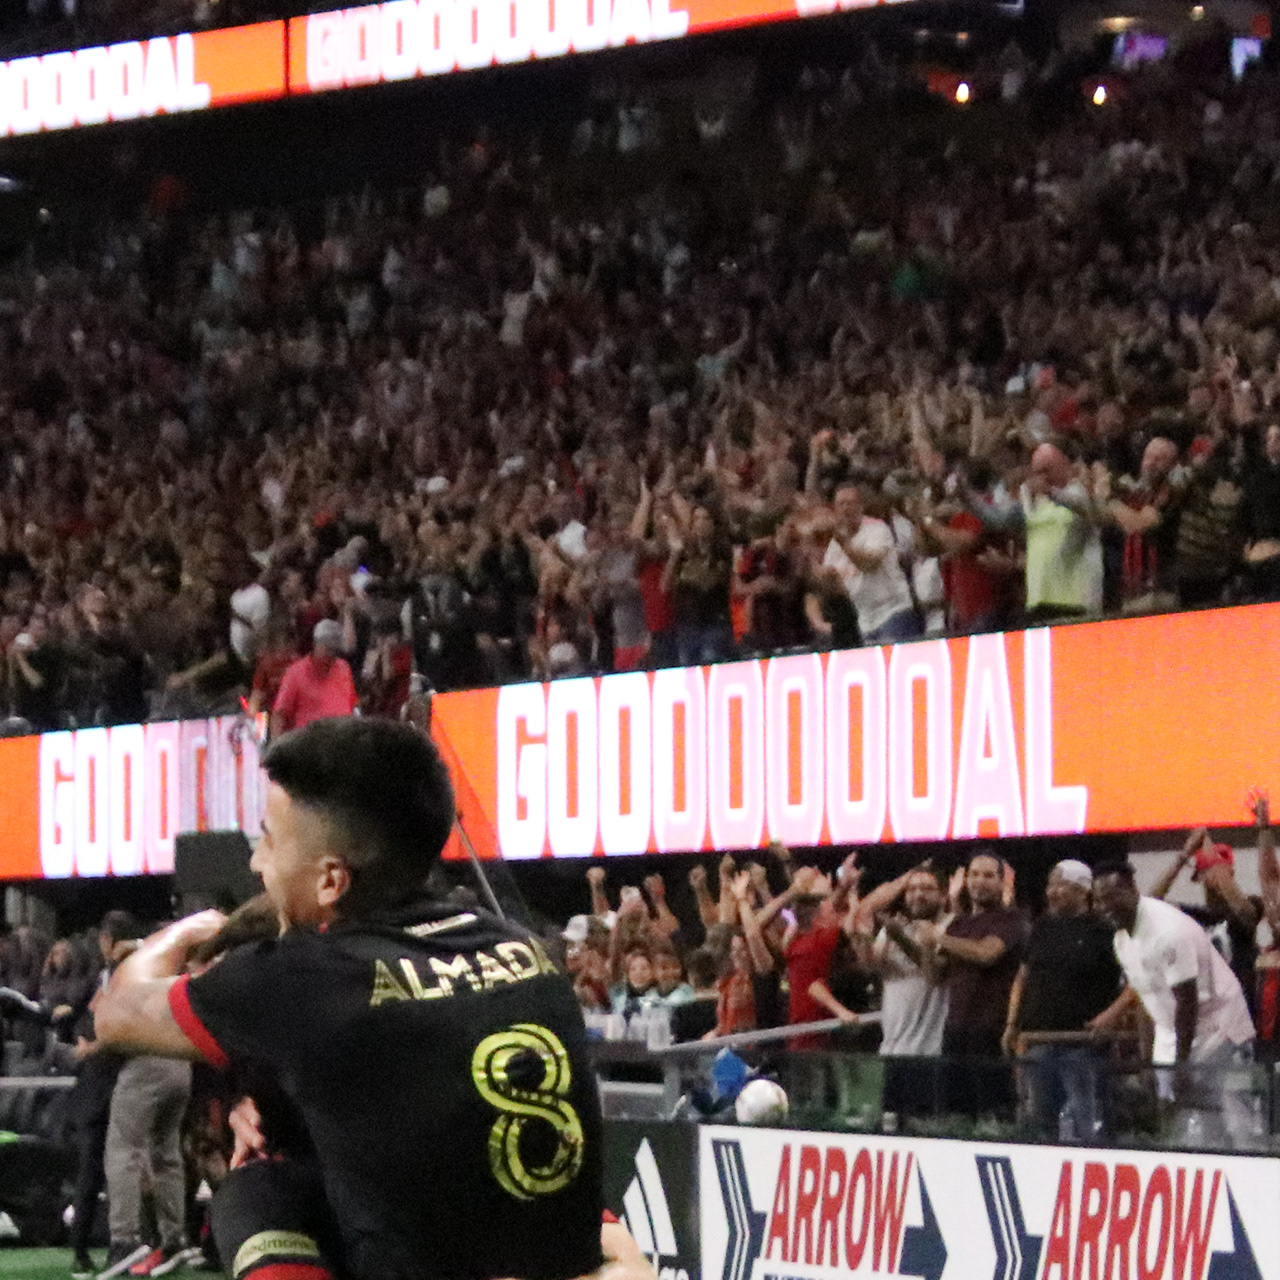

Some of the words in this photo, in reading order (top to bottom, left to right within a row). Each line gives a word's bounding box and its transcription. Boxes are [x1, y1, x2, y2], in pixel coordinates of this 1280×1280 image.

[496, 625, 1088, 861] GOOOOOOOAL
[471, 1022, 584, 1200] 8
[765, 1143, 914, 1275] ARROW
